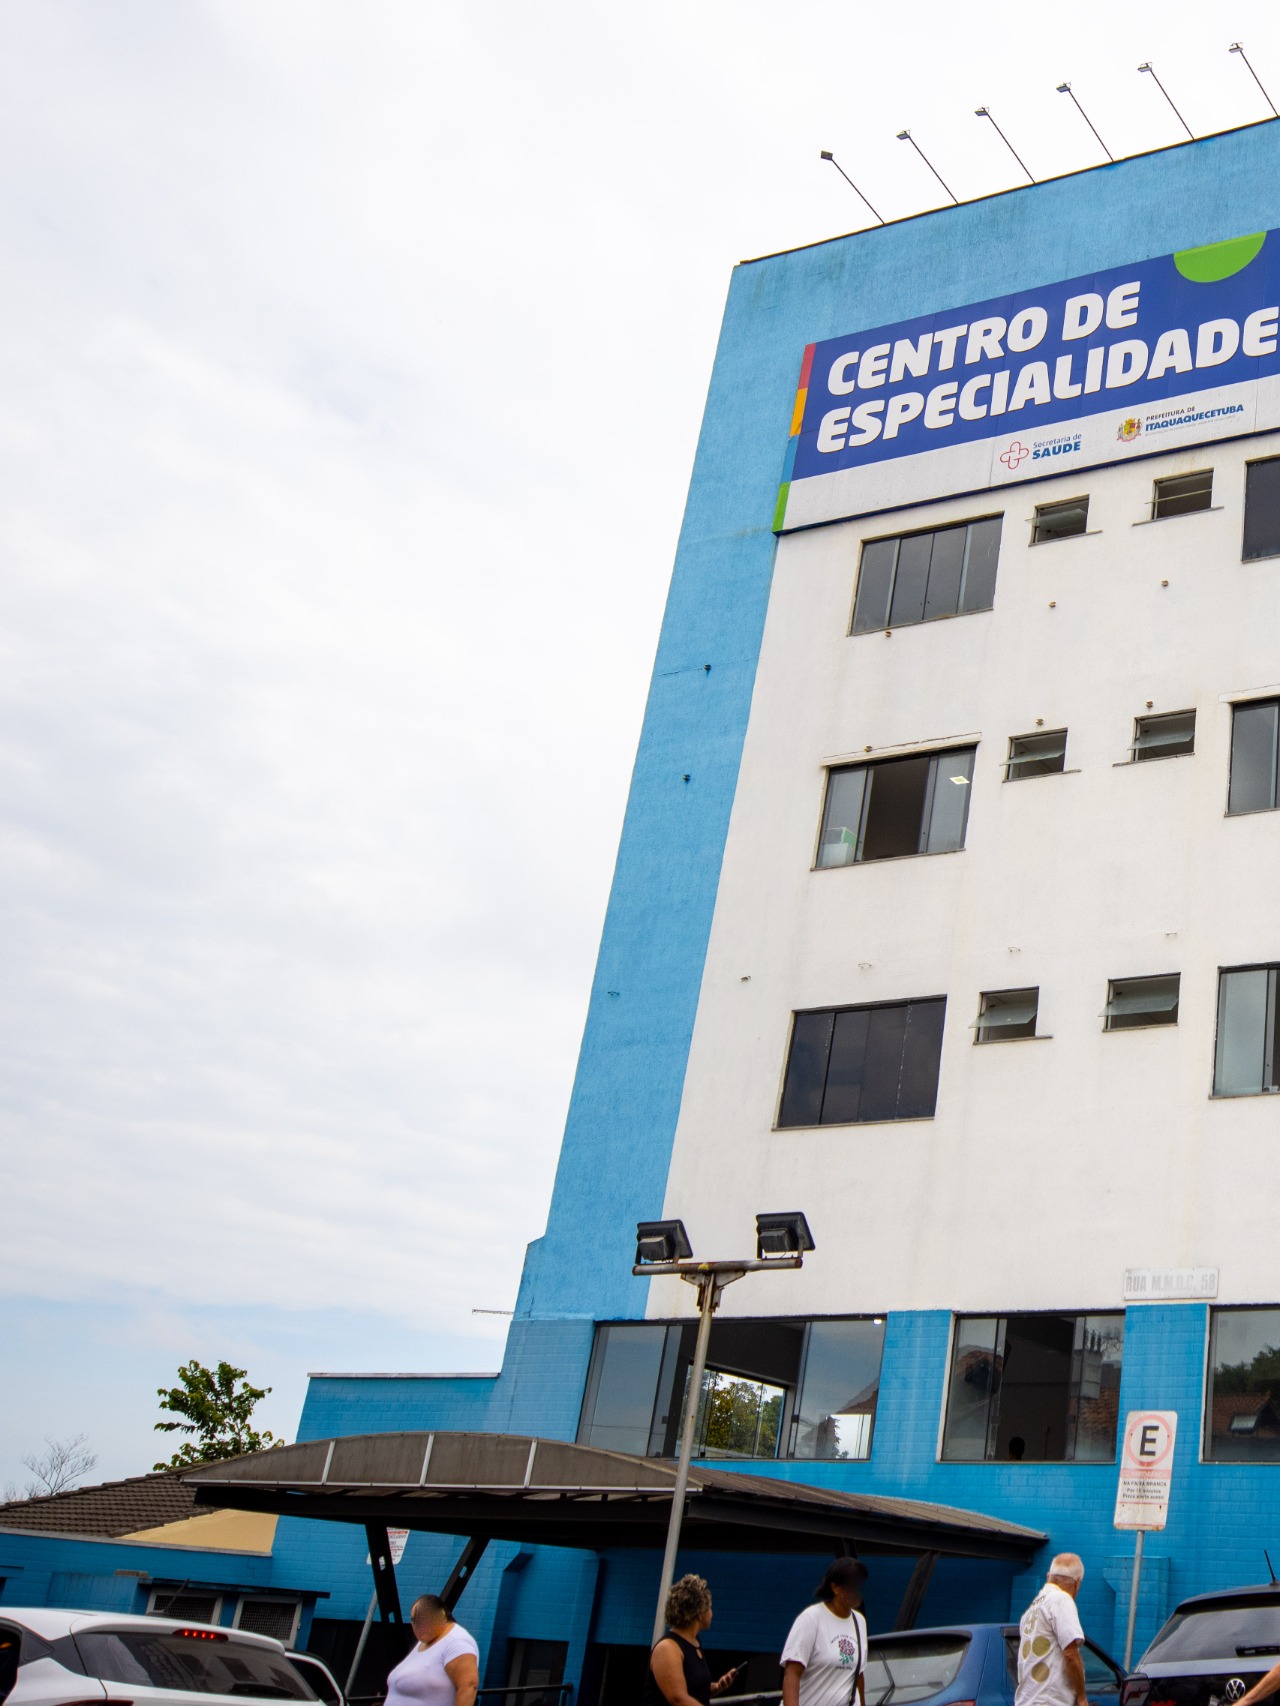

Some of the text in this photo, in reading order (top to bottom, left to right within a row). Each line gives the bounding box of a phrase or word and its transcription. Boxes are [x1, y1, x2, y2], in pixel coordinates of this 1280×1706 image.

[828, 281, 1140, 395] CENTRO DE
[1146, 409, 1184, 421] PREFEITURA
[1146, 404, 1244, 431] ITAQUAQUECETUBA
[1033, 436, 1070, 448] Secretaria
[1126, 1276, 1146, 1292] RUA
[1140, 1426, 1159, 1456] E
